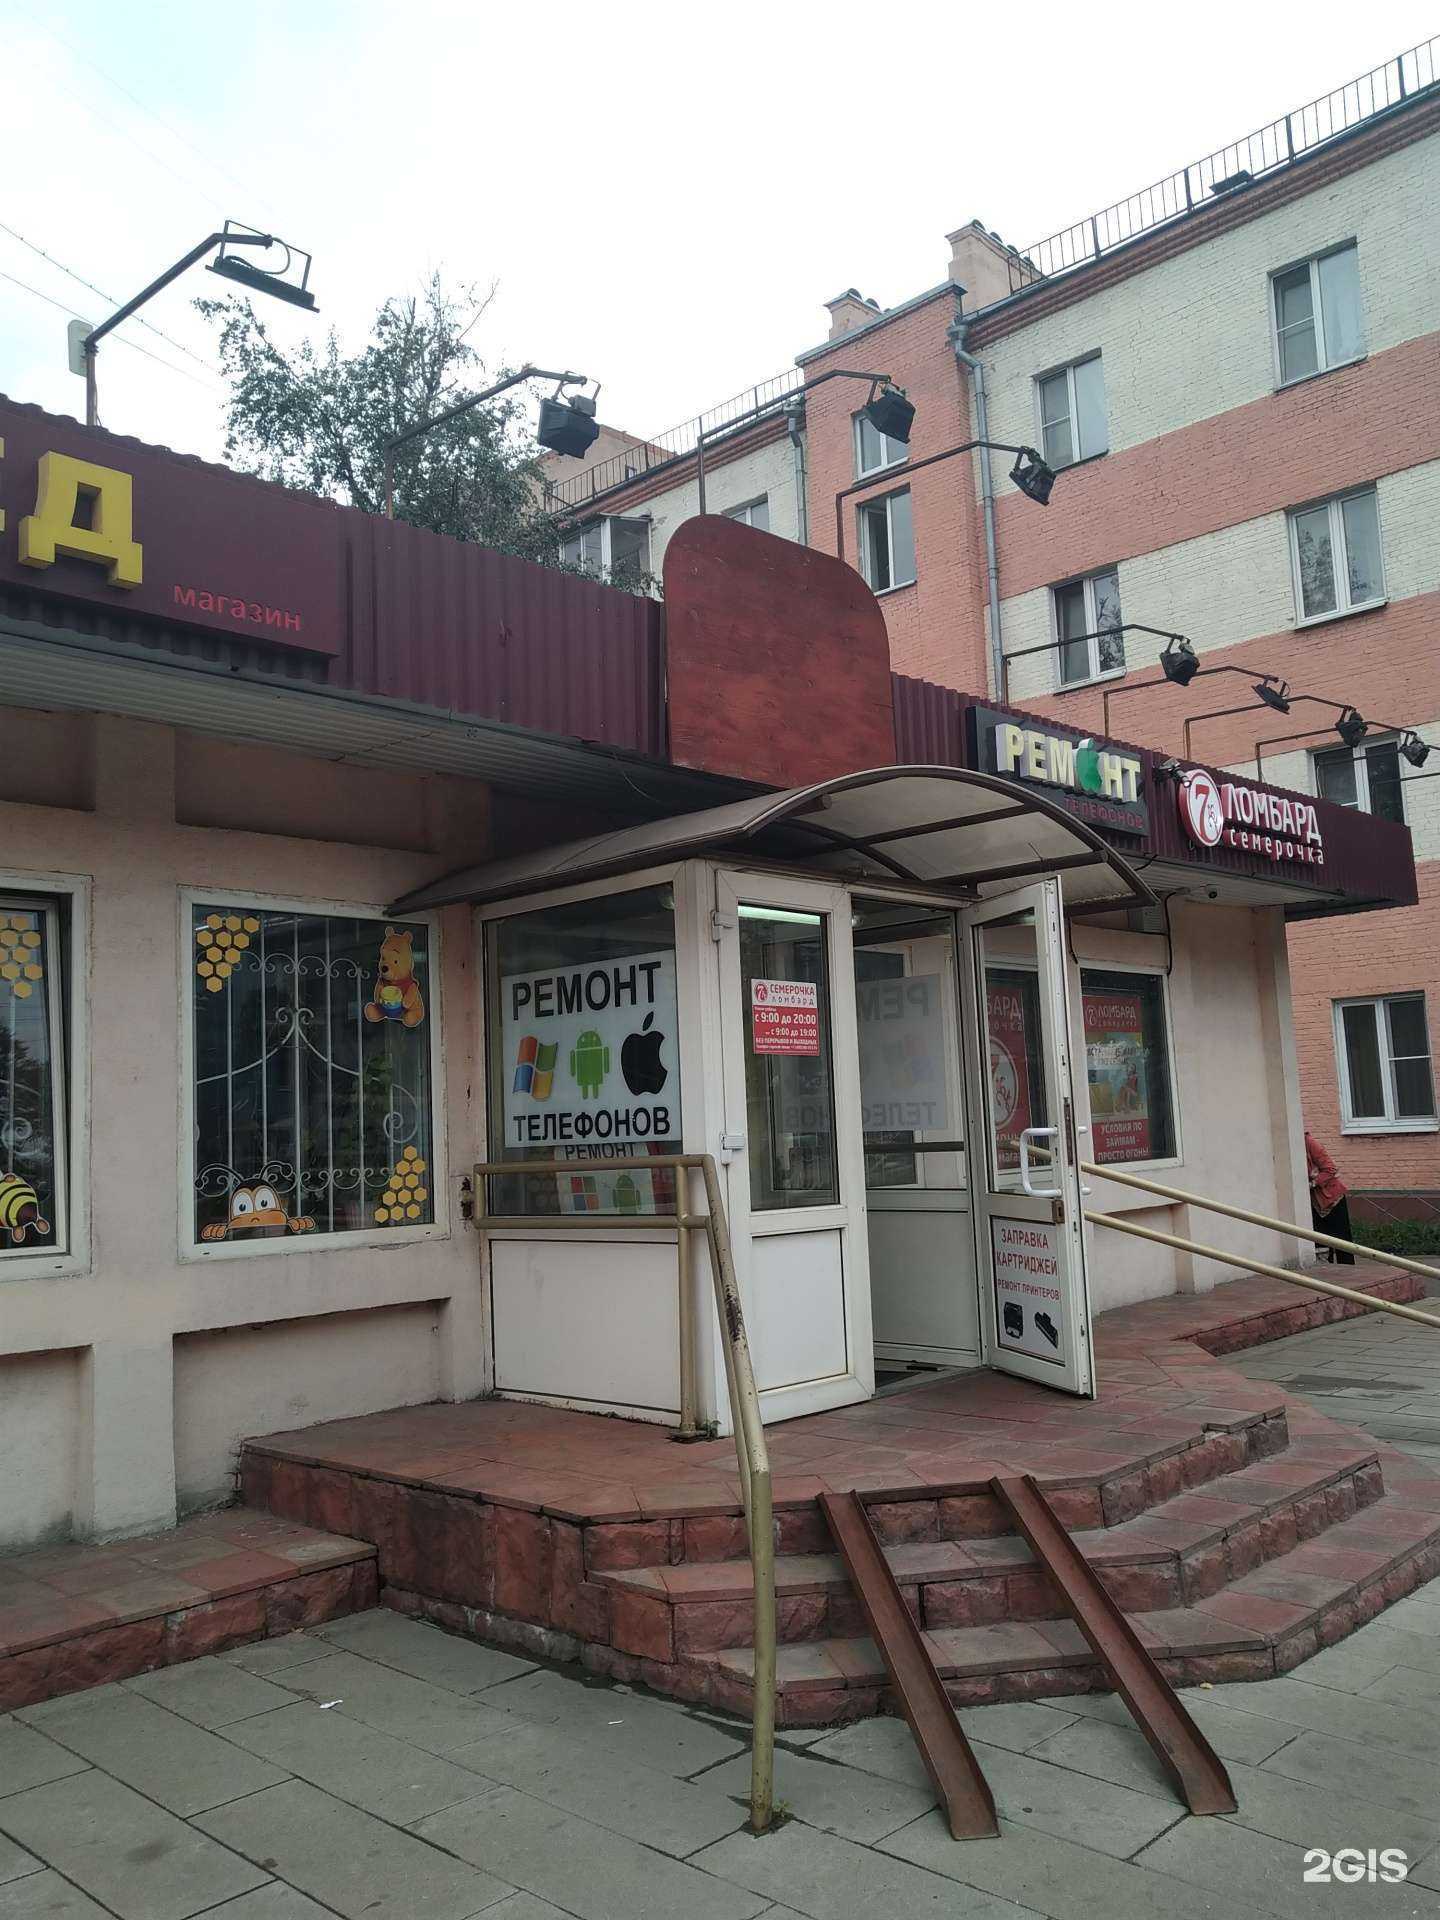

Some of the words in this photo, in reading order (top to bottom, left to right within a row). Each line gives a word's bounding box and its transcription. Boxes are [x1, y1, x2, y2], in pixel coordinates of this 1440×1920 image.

[173, 585, 301, 631] магазин
[1221, 783, 1323, 846] ЛОМБАРД
[1229, 829, 1324, 864] семерочка
[512, 961, 662, 1021] РЕМОНТ
[770, 983, 815, 996] СЕМЕРОЧКА
[760, 1012, 779, 1023] 9:00
[781, 1015, 791, 1025] до
[793, 1013, 816, 1025] 20:00
[775, 1028, 790, 1036] 9:00
[800, 1029, 816, 1037] 19:00
[512, 1106, 671, 1142] ТЕЛЕФОНОВ
[564, 1141, 636, 1161] РЕМОНТ
[1001, 1228, 1049, 1249] ЗАПРАВКА
[996, 1251, 1058, 1277] КАРТРИДЖЕЙ
[997, 1278, 1021, 1292] РЕМОНТ
[1022, 1281, 1060, 1301] ПРИНТЕРОВ
